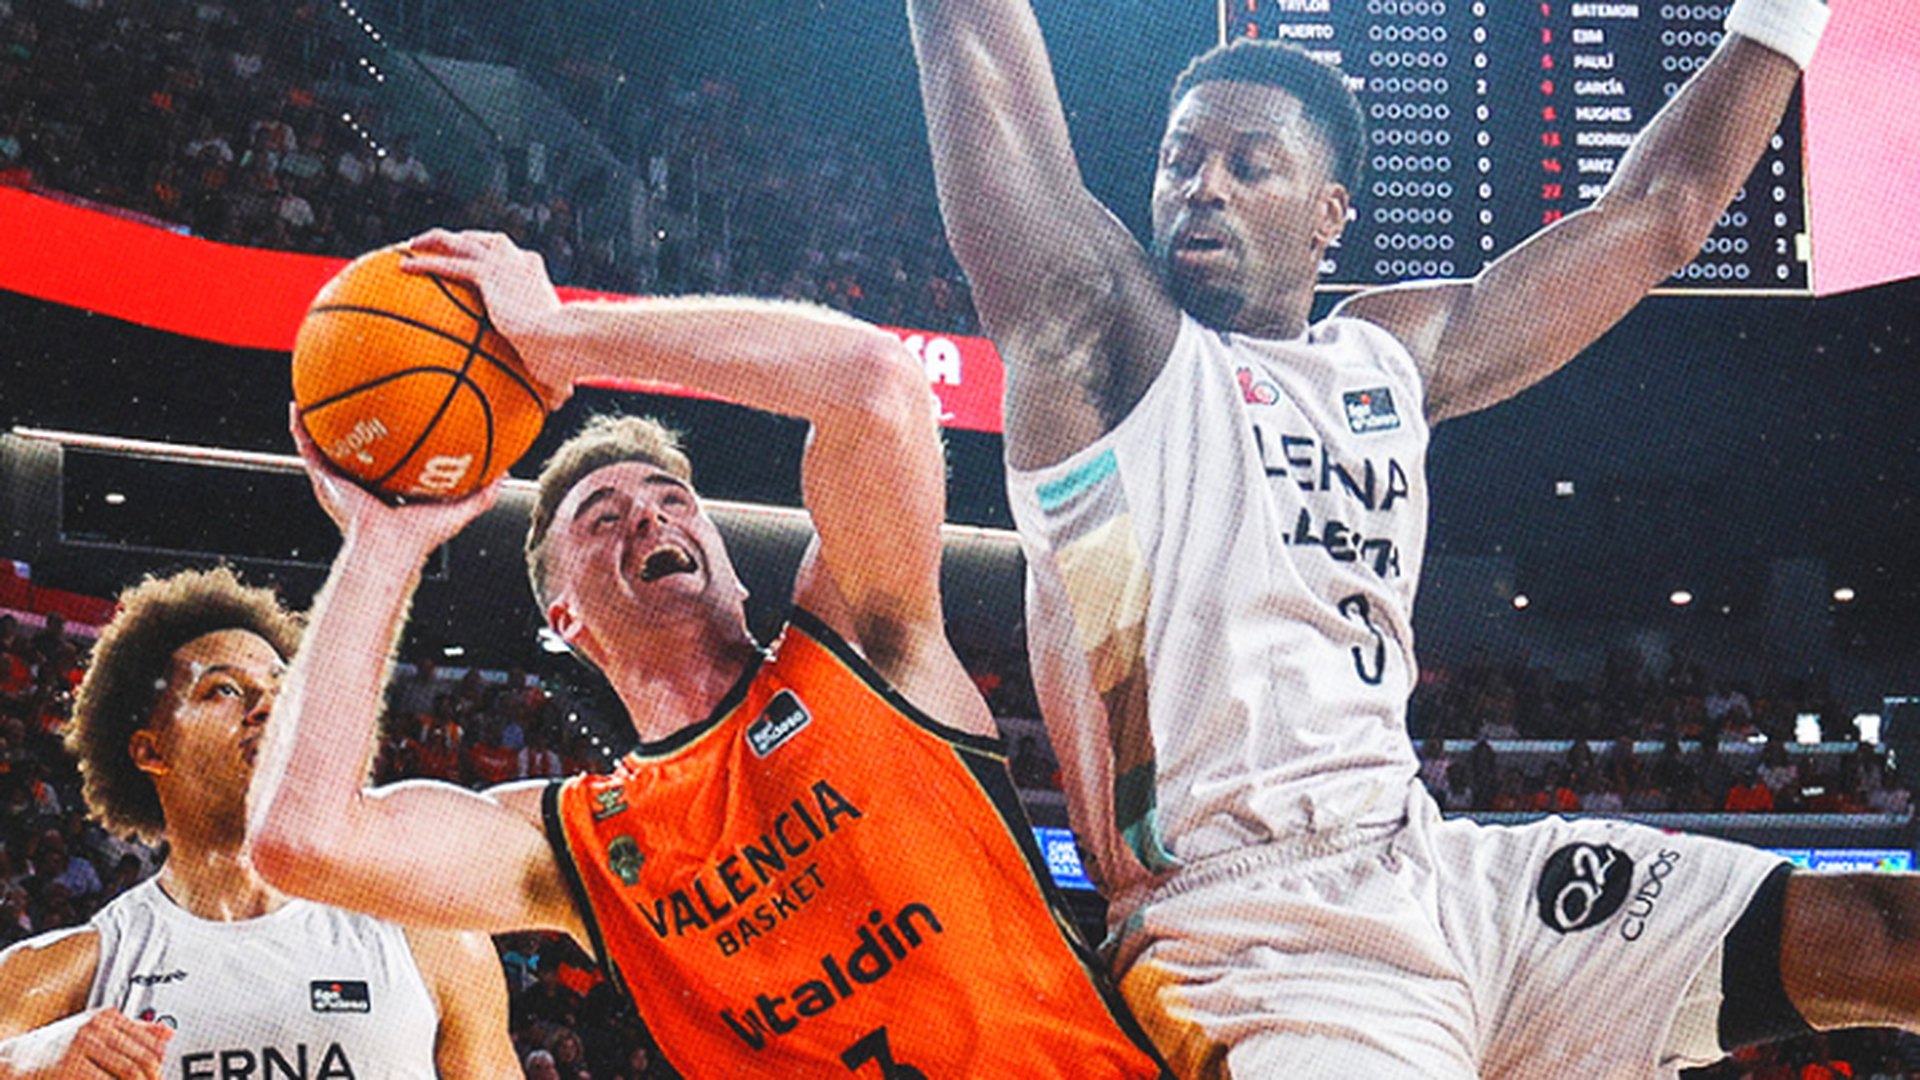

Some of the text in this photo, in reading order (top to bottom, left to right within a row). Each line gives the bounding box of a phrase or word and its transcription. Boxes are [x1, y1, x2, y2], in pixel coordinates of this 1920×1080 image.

[1278, 24, 1334, 39] PUERTO
[1574, 77, 1625, 95] GARCÍA
[1575, 107, 1632, 121] HUGHES
[1577, 158, 1615, 173] SANZ
[637, 780, 863, 939] VALENCIA
[715, 863, 827, 957] BASKET
